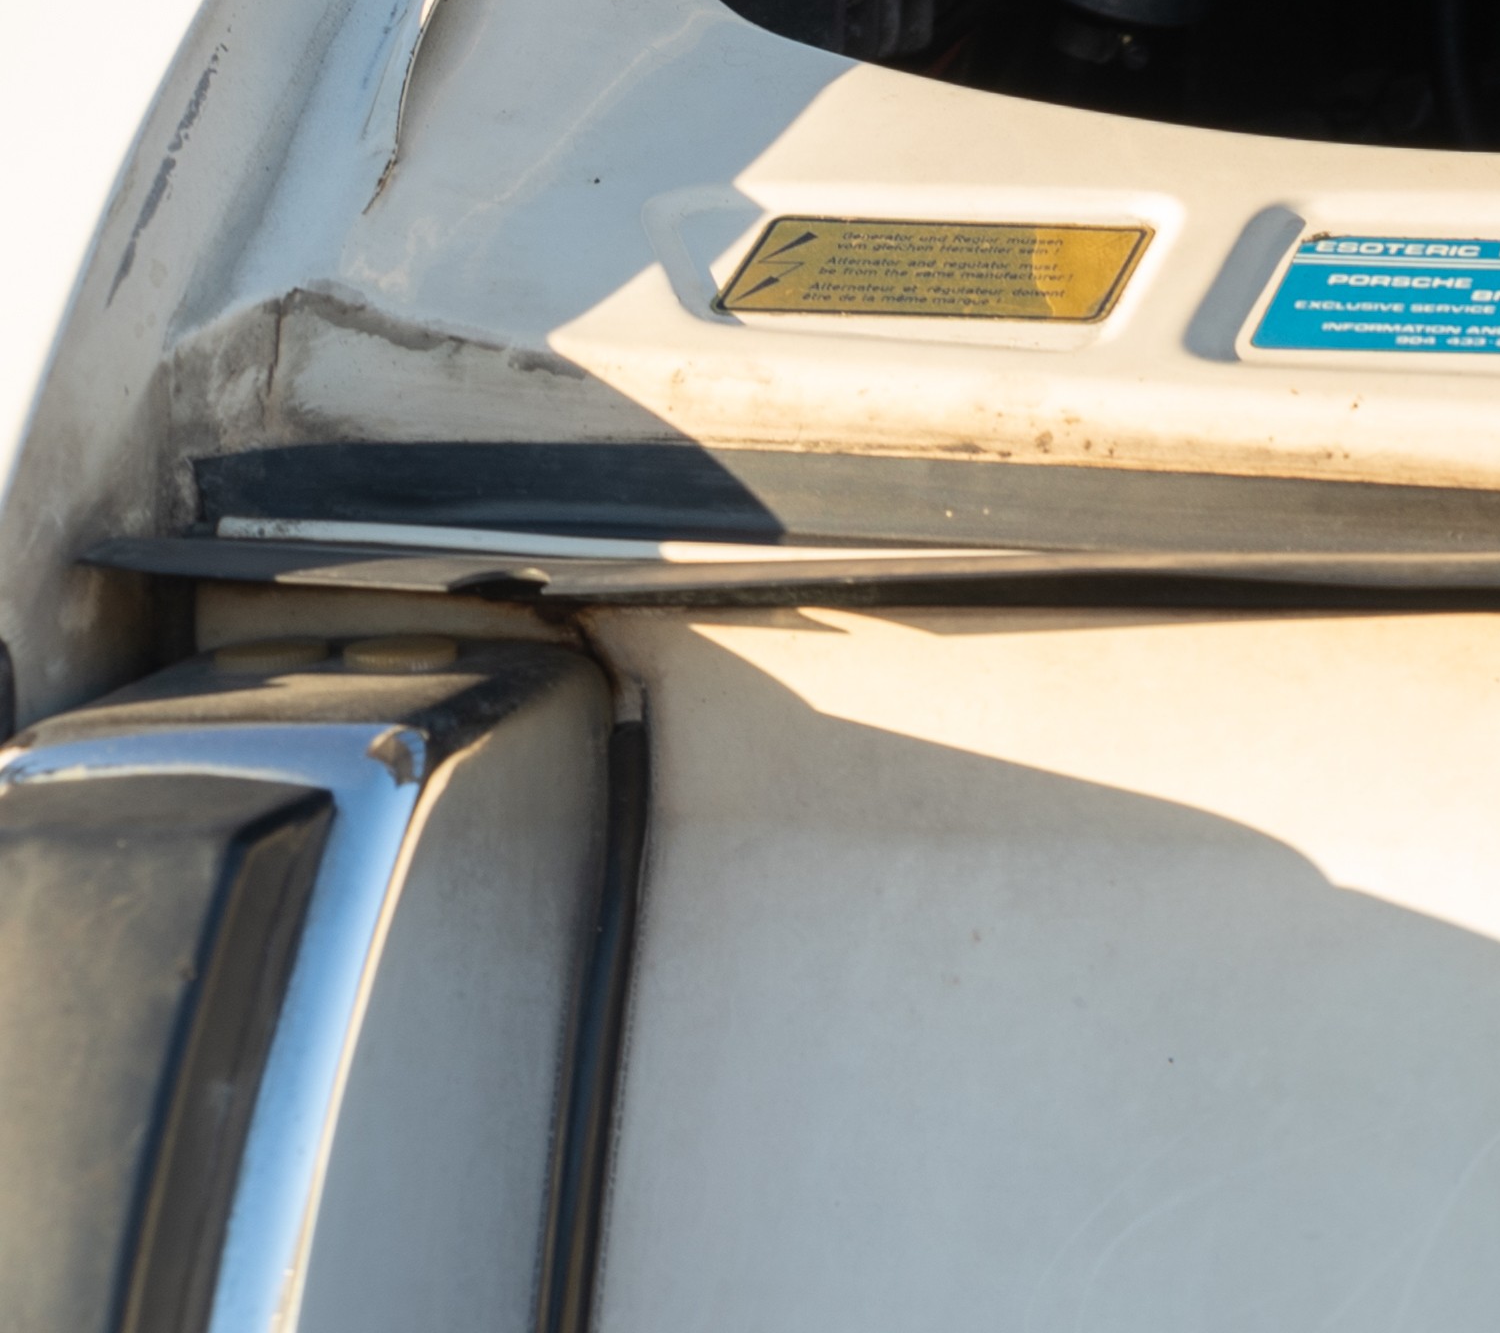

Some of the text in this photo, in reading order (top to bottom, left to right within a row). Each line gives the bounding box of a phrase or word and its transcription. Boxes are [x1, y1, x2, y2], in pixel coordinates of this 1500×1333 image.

[1315, 239, 1481, 257] ESOTERIC
[827, 256, 899, 267] Alternator
[908, 259, 936, 267] and
[943, 261, 1008, 270] regulator
[818, 267, 836, 275] be
[844, 267, 878, 276] from
[884, 268, 907, 276] the
[809, 282, 895, 292] Alternateur
[1327, 273, 1473, 289] PORSCHE
[839, 294, 856, 302] de
[862, 294, 875, 302] la
[1294, 300, 1404, 313] EXCLUSIVE
[1410, 303, 1496, 315] SERVICE
[1321, 322, 1461, 335] INFORMATION
